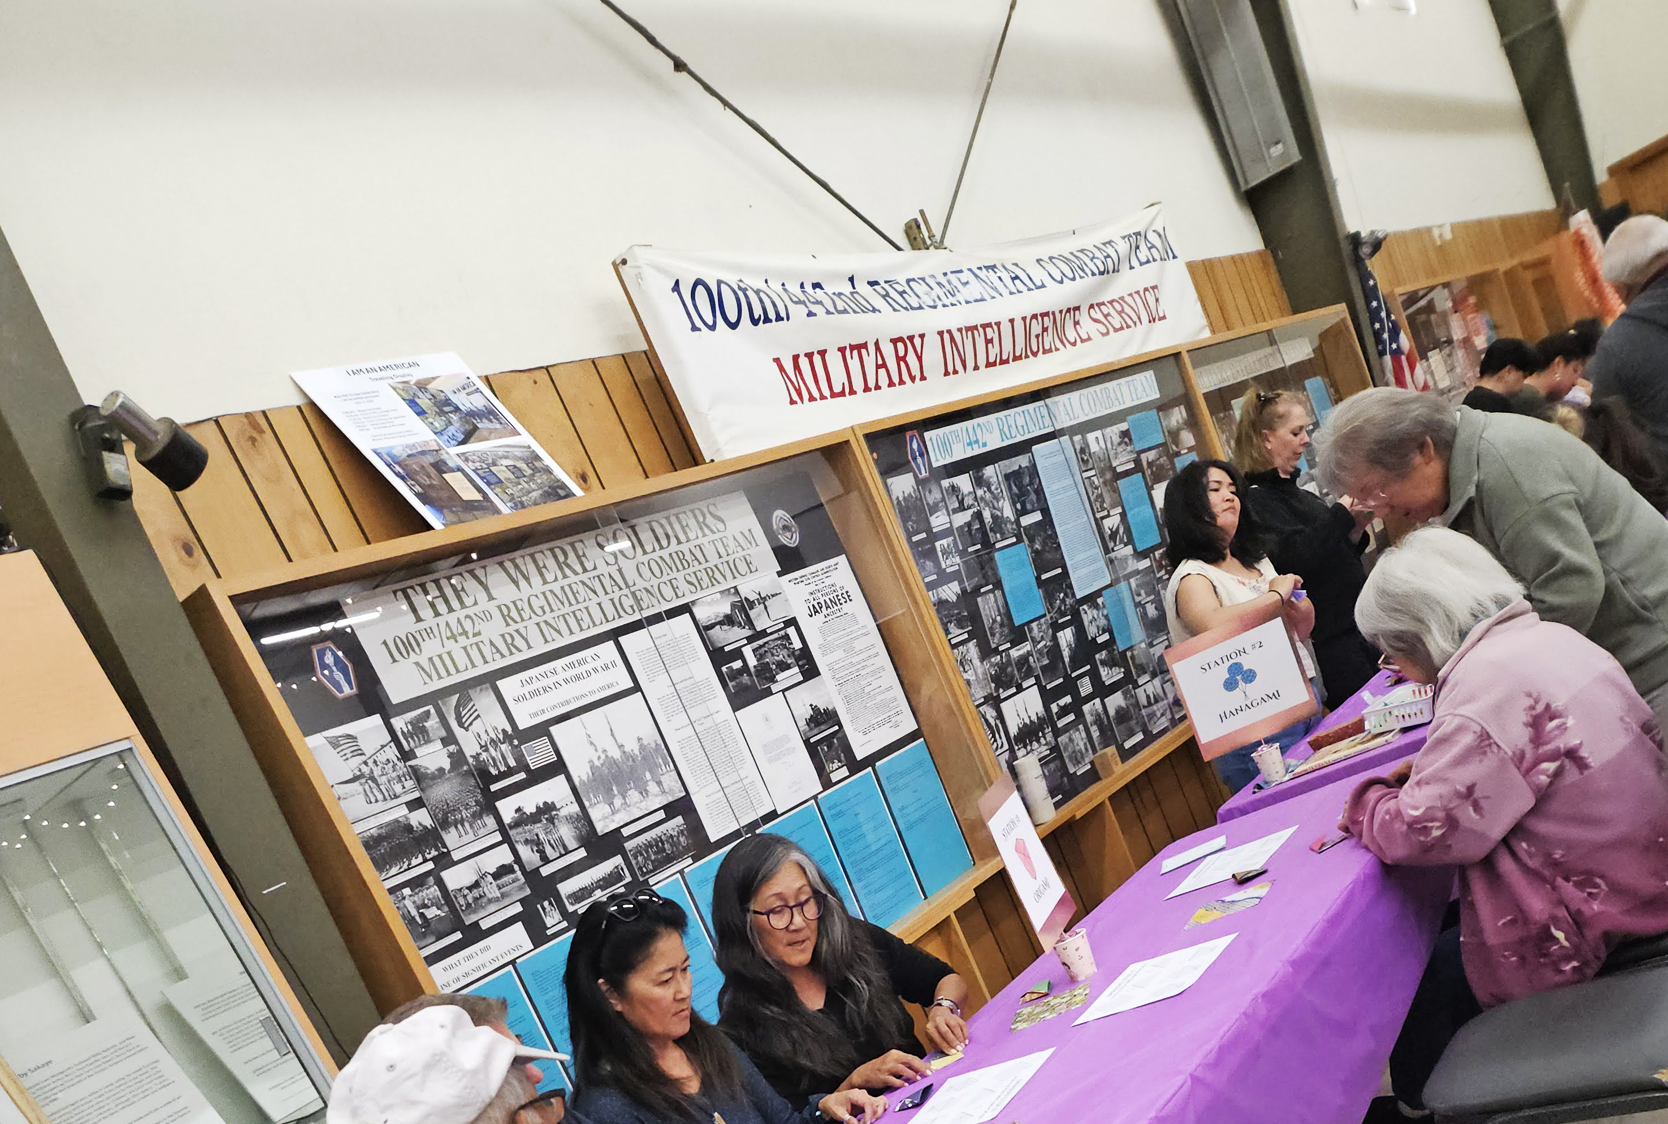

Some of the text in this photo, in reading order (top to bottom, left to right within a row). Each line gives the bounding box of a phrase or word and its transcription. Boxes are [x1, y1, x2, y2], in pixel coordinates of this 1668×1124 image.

[866, 262, 1046, 312] REGIMENTAL
[1036, 239, 1121, 285] COMBAT
[1121, 226, 1178, 271] TEAM
[772, 284, 1167, 405] MILITARY INTELLIGENCE SERVICE
[377, 361, 420, 373] AMERICAN
[995, 397, 1080, 443] REGIMENTAL
[1078, 382, 1127, 417] COMBAT
[1125, 373, 1159, 403] TEAM
[392, 503, 728, 625] THEY WERE SOLDIERS
[496, 566, 636, 628] REGIMENTAL
[635, 541, 712, 583] COMBAT
[707, 528, 760, 560] TEAM
[411, 553, 759, 686] MILITARY INTELLIGENCE SERVICE
[807, 590, 853, 618] JAPANESE
[519, 651, 602, 688] JAPANESE AMERICAN
[1200, 646, 1250, 675] STATION
[512, 684, 554, 705] SOLDIERS
[552, 680, 563, 690] IN
[562, 669, 593, 686] WORLD
[592, 663, 610, 676] WAR
[1218, 689, 1282, 724] HANAGAMI
[442, 943, 492, 973] WHAT THEY DID
[460, 956, 500, 980] SIGNIFICANT
[499, 943, 524, 957] EVENTS
